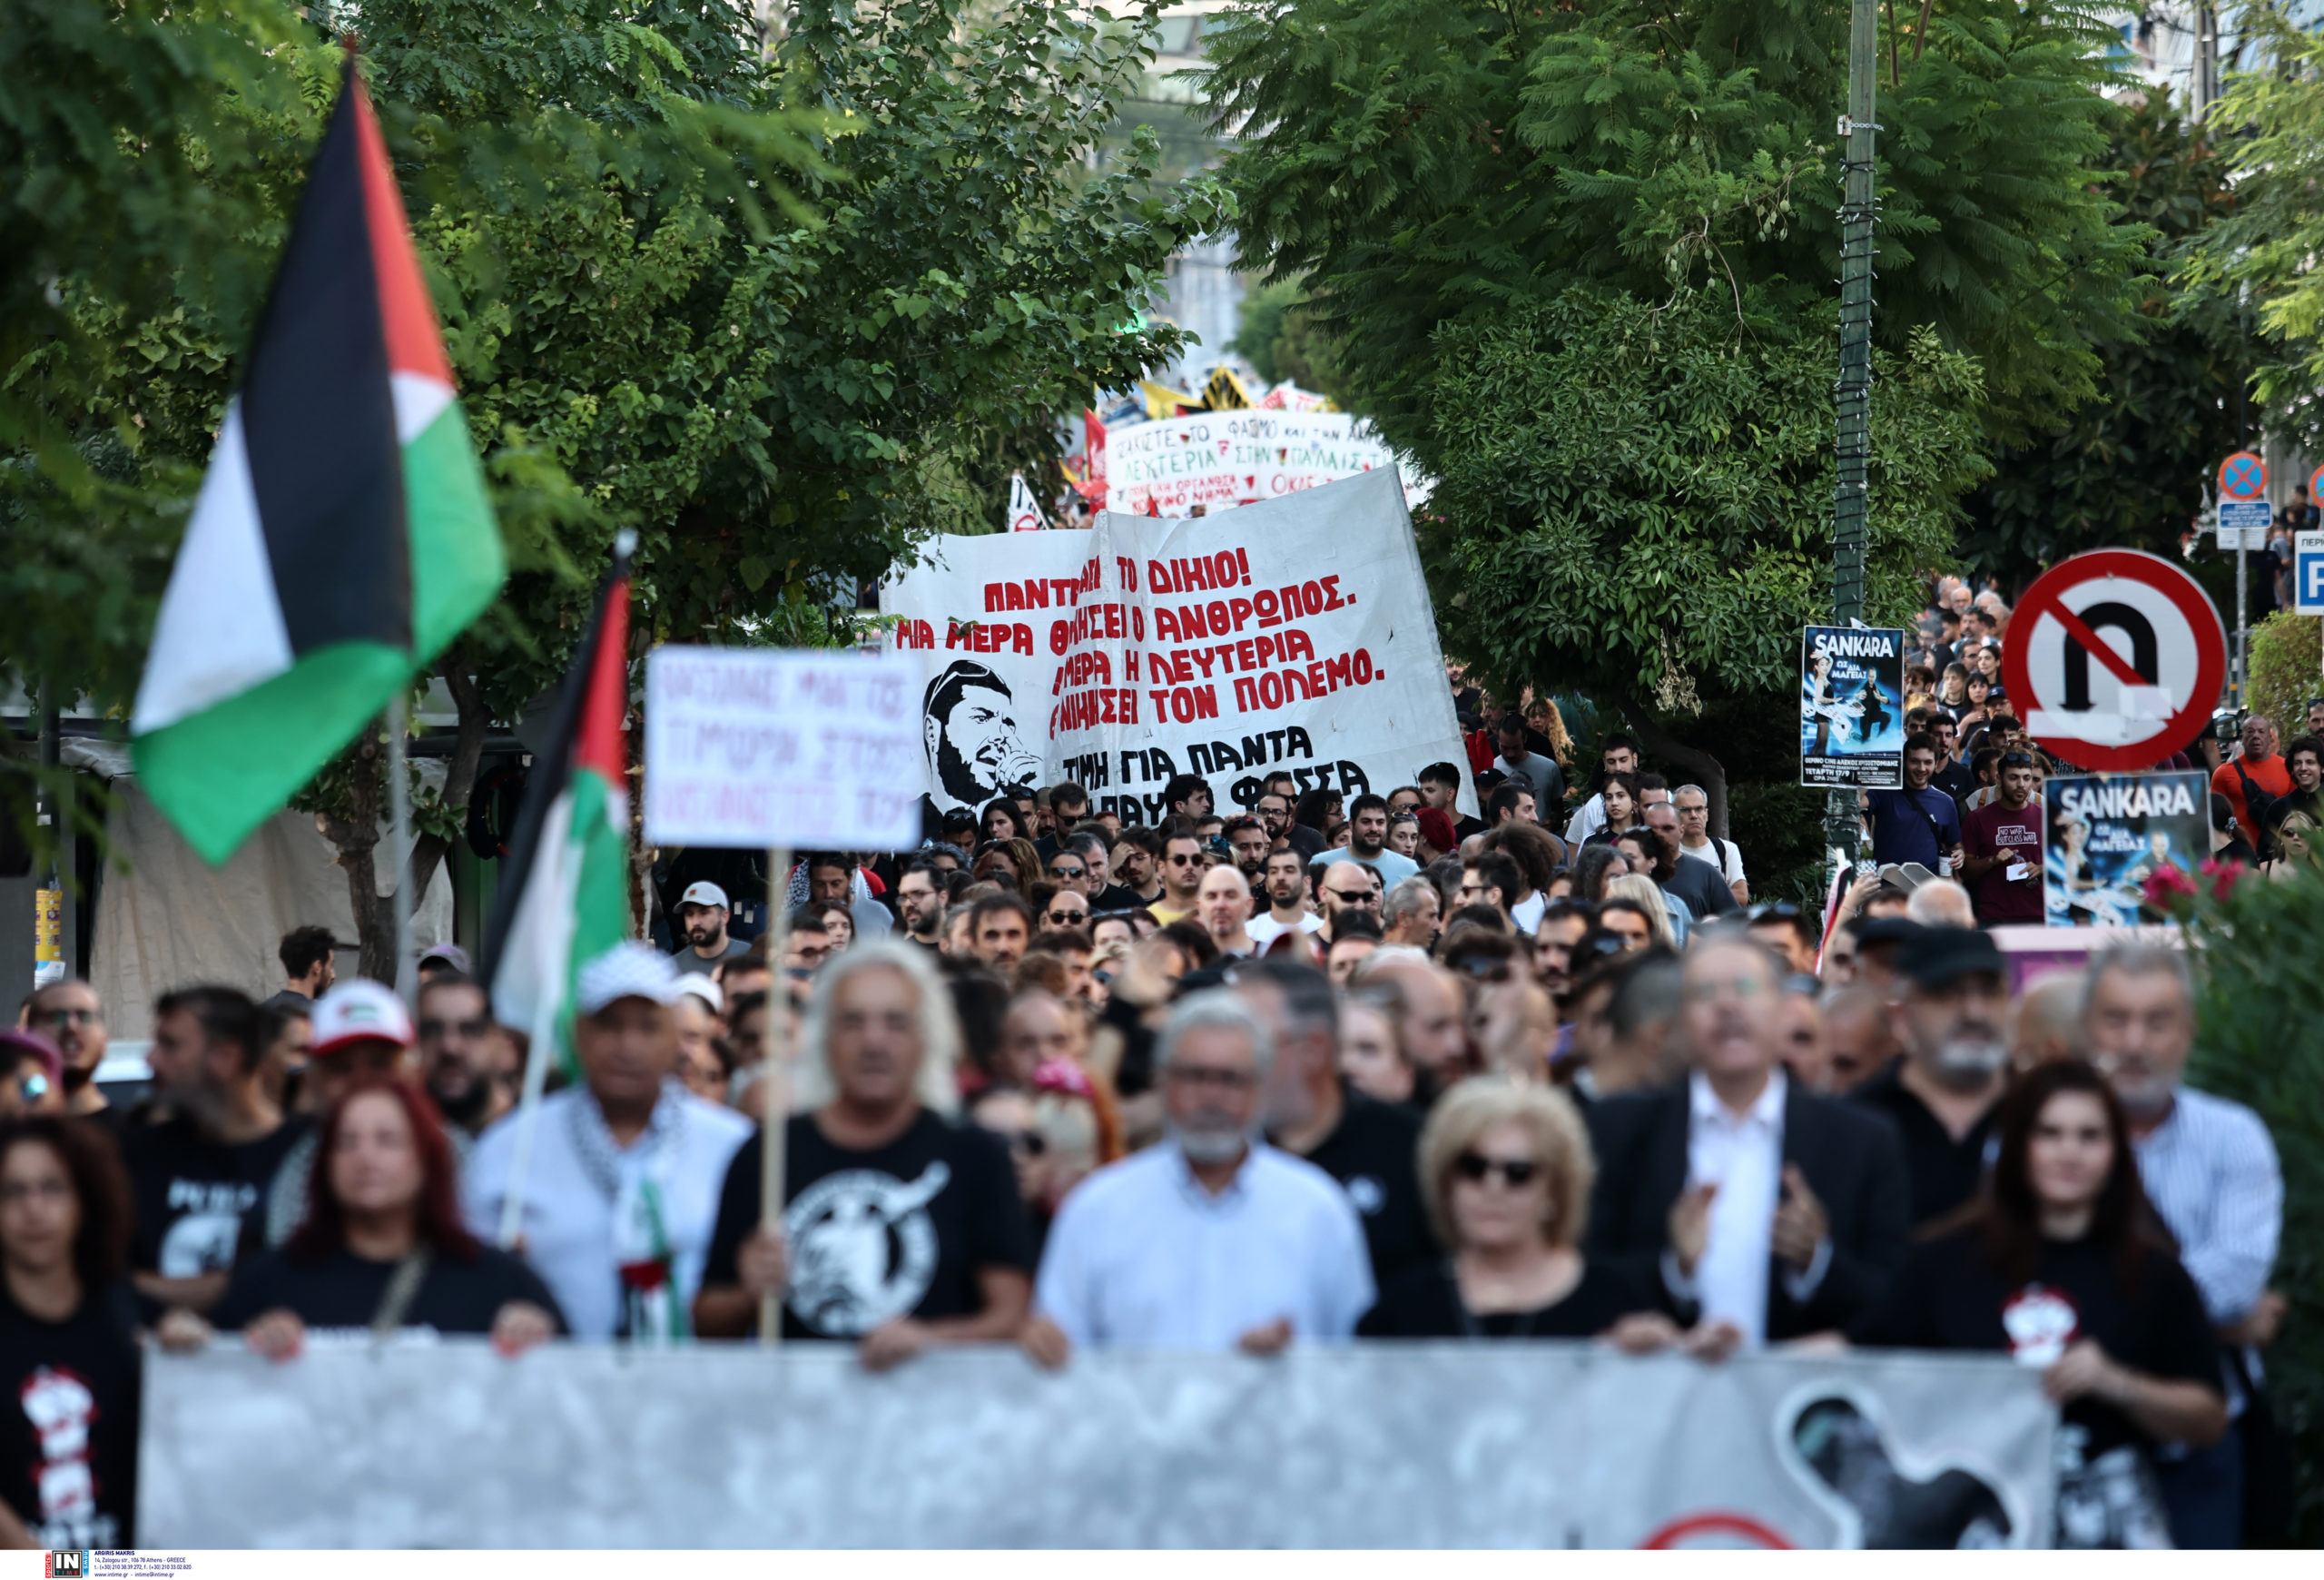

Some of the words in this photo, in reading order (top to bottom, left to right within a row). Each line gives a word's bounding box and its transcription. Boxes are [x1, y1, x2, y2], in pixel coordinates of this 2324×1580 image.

[1117, 556, 1137, 593] ΤΟ
[1147, 547, 1252, 594] ΔΙΚΙΟ!
[896, 619, 935, 649] ΜΙΑ
[945, 621, 1034, 657] ΜΕΡΑ
[1132, 606, 1145, 643] Ο
[1154, 574, 1357, 644] ΑΝΘΡΩΠΟΣ.
[1125, 649, 1140, 682] Η
[1147, 628, 1315, 686] ΛΕΥΤΕΡΙΑ
[1815, 634, 1895, 657] SANKARA
[1148, 684, 1220, 724] ΤΟΝ
[1232, 647, 1385, 714] ΠΟΛΕΜΟ.
[1831, 670, 1867, 680] ΜΑΓΕΙΑΣ
[1063, 751, 1108, 792] ΤΙΜΗ
[1120, 746, 1178, 785] ΓΙΑ
[1186, 726, 1315, 776] ΠΑΝΤΑ
[1805, 767, 1834, 775] ΤΕΤΑΡΤΗ
[1835, 769, 1850, 777] 17/9
[1230, 759, 1371, 813] ΦΣΣΑ
[2061, 784, 2196, 818] SANKARA
[2009, 827, 2024, 835] WAR
